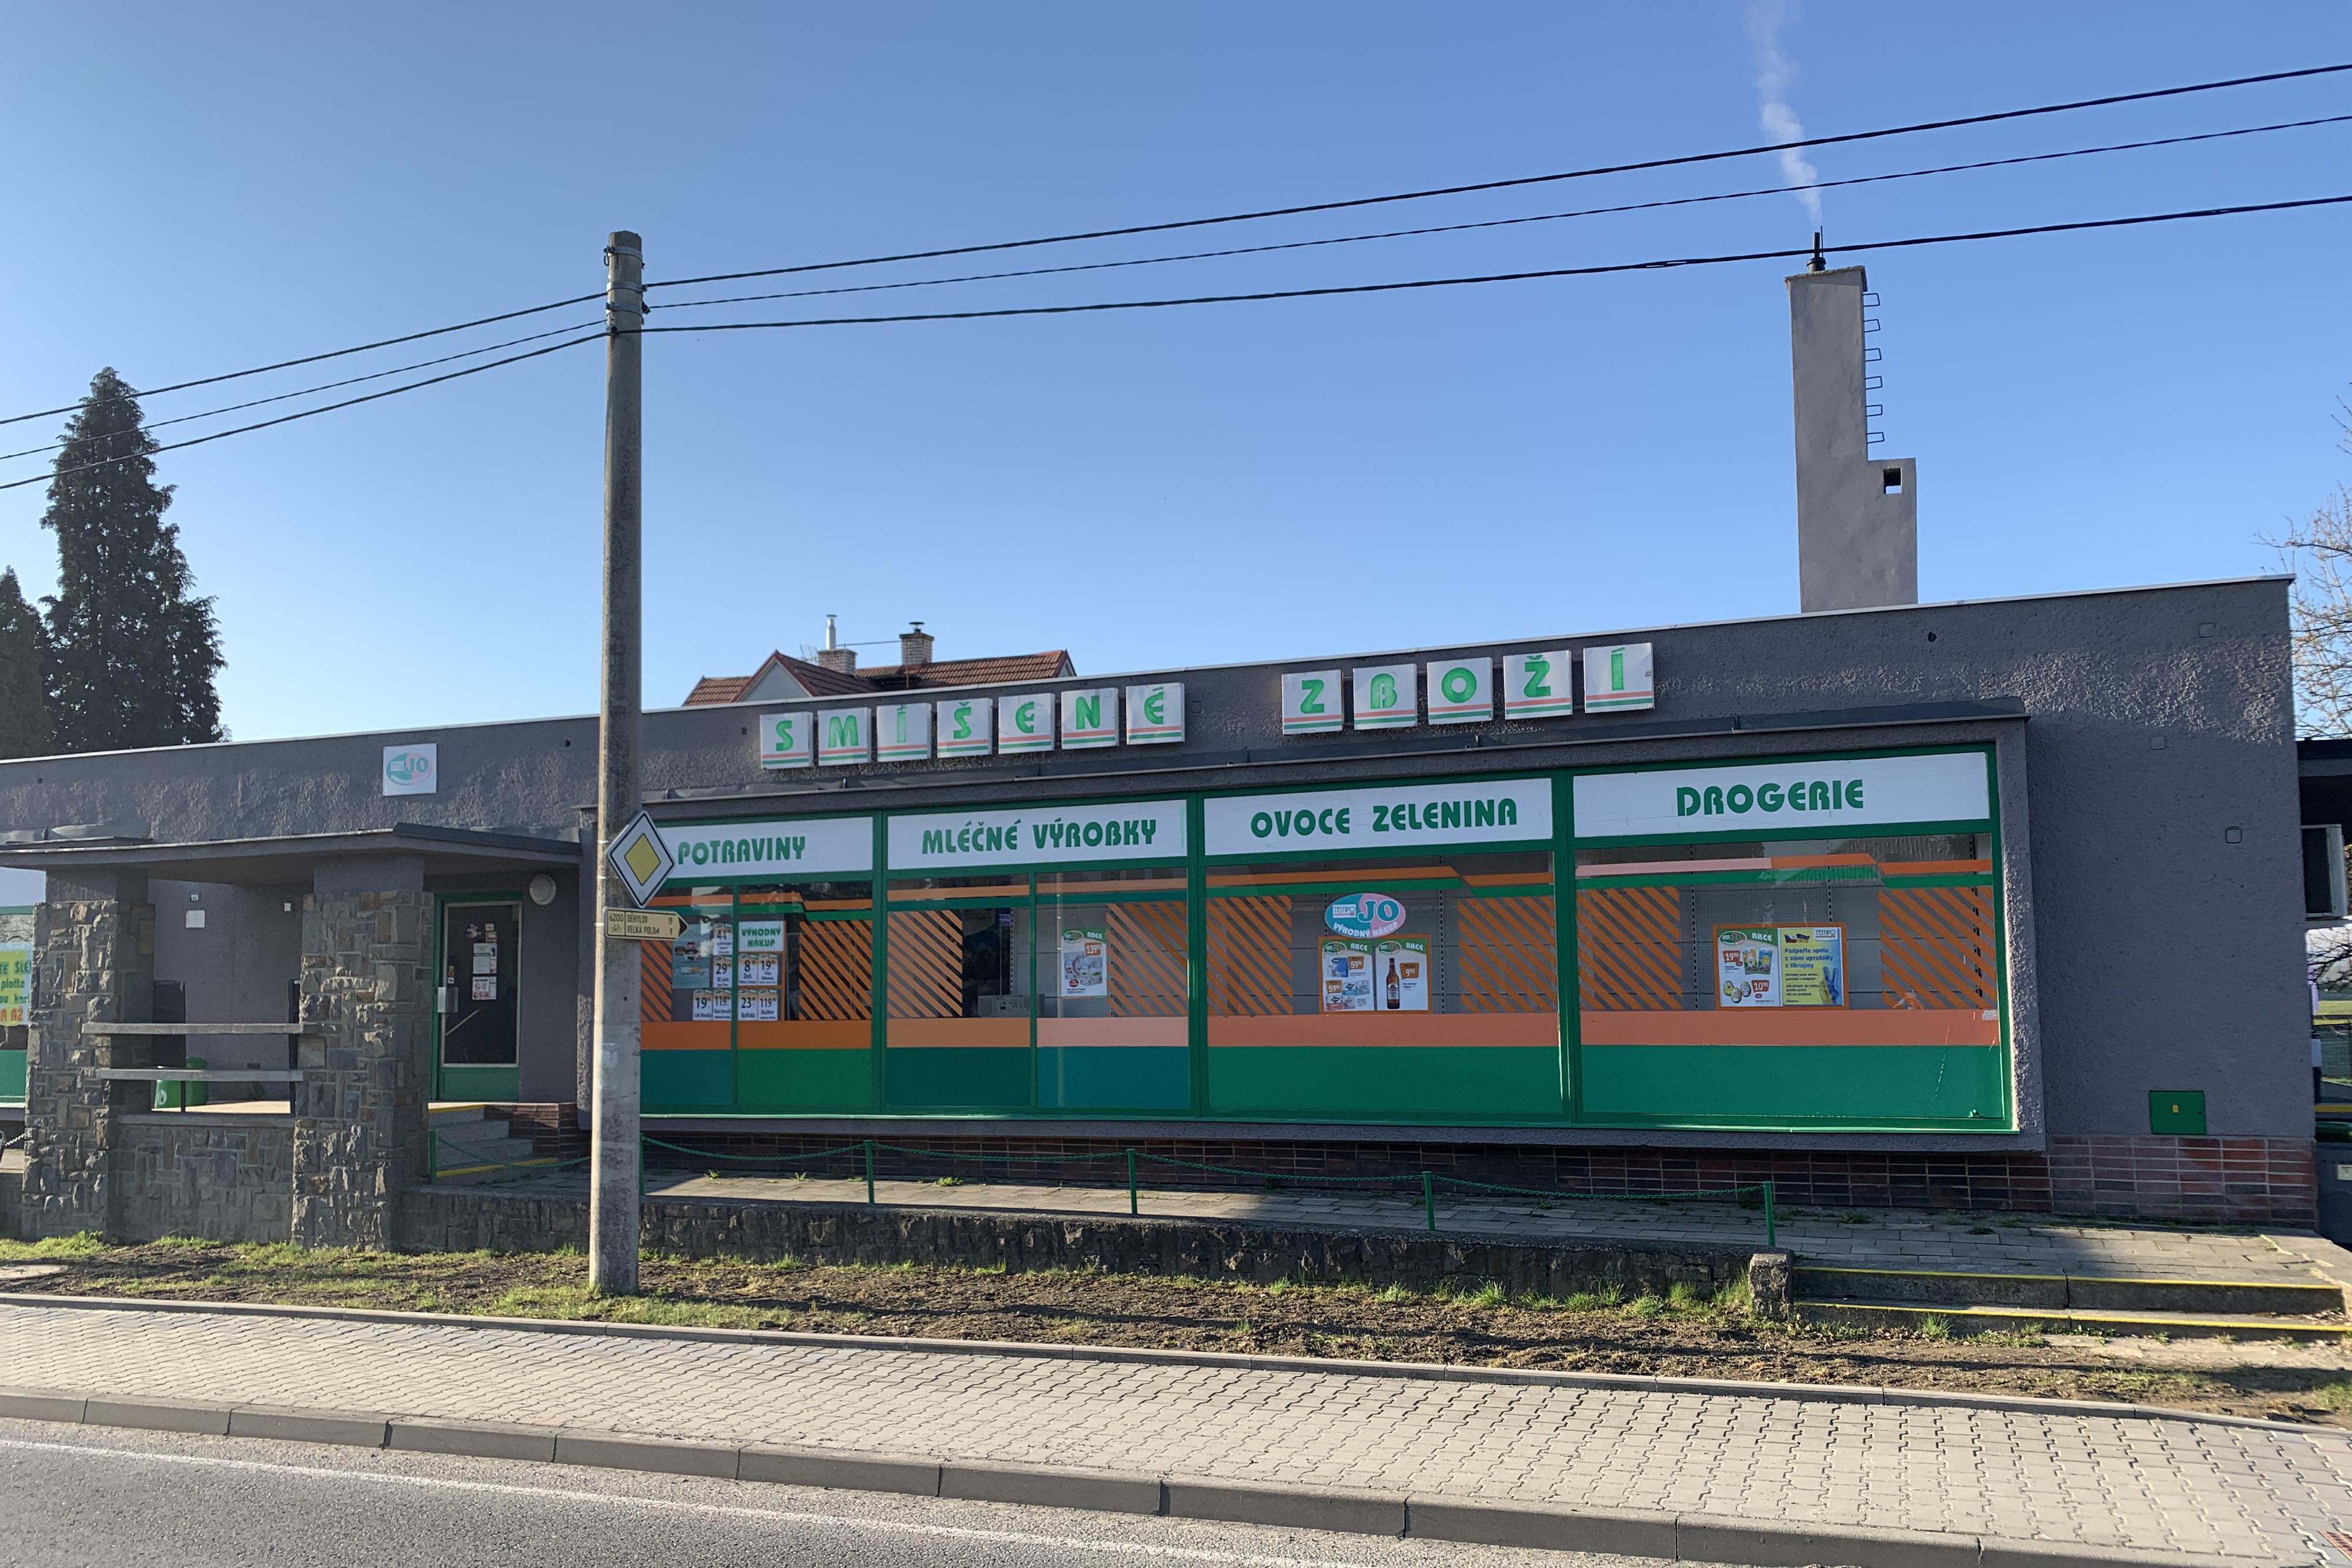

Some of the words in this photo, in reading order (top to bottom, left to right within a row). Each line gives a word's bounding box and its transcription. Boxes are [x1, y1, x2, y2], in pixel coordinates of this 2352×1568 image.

[1300, 647, 1626, 714] ZBOŽÍ
[405, 757, 429, 773] JO
[1676, 780, 1863, 817] DROGERIE
[1251, 807, 1350, 838] OVOCE
[1372, 798, 1517, 832] ZELENINA
[922, 819, 1021, 854] MLÉČNÉ
[1033, 818, 1156, 849] VÝROBKY
[678, 836, 806, 865] POTRAVINY
[609, 914, 623, 922] 6200
[1357, 900, 1399, 922] JO
[742, 926, 781, 937] VÝHODNÝ
[1333, 922, 1371, 937] VÝHODNÝ
[1372, 921, 1398, 936] NÁKUP
[1752, 932, 1772, 941] AKCE
[748, 938, 775, 947] NÁKUP
[1350, 943, 1368, 951] AKCE
[1406, 942, 1424, 951] AKCE
[11, 1007, 23, 1021] AŽ
